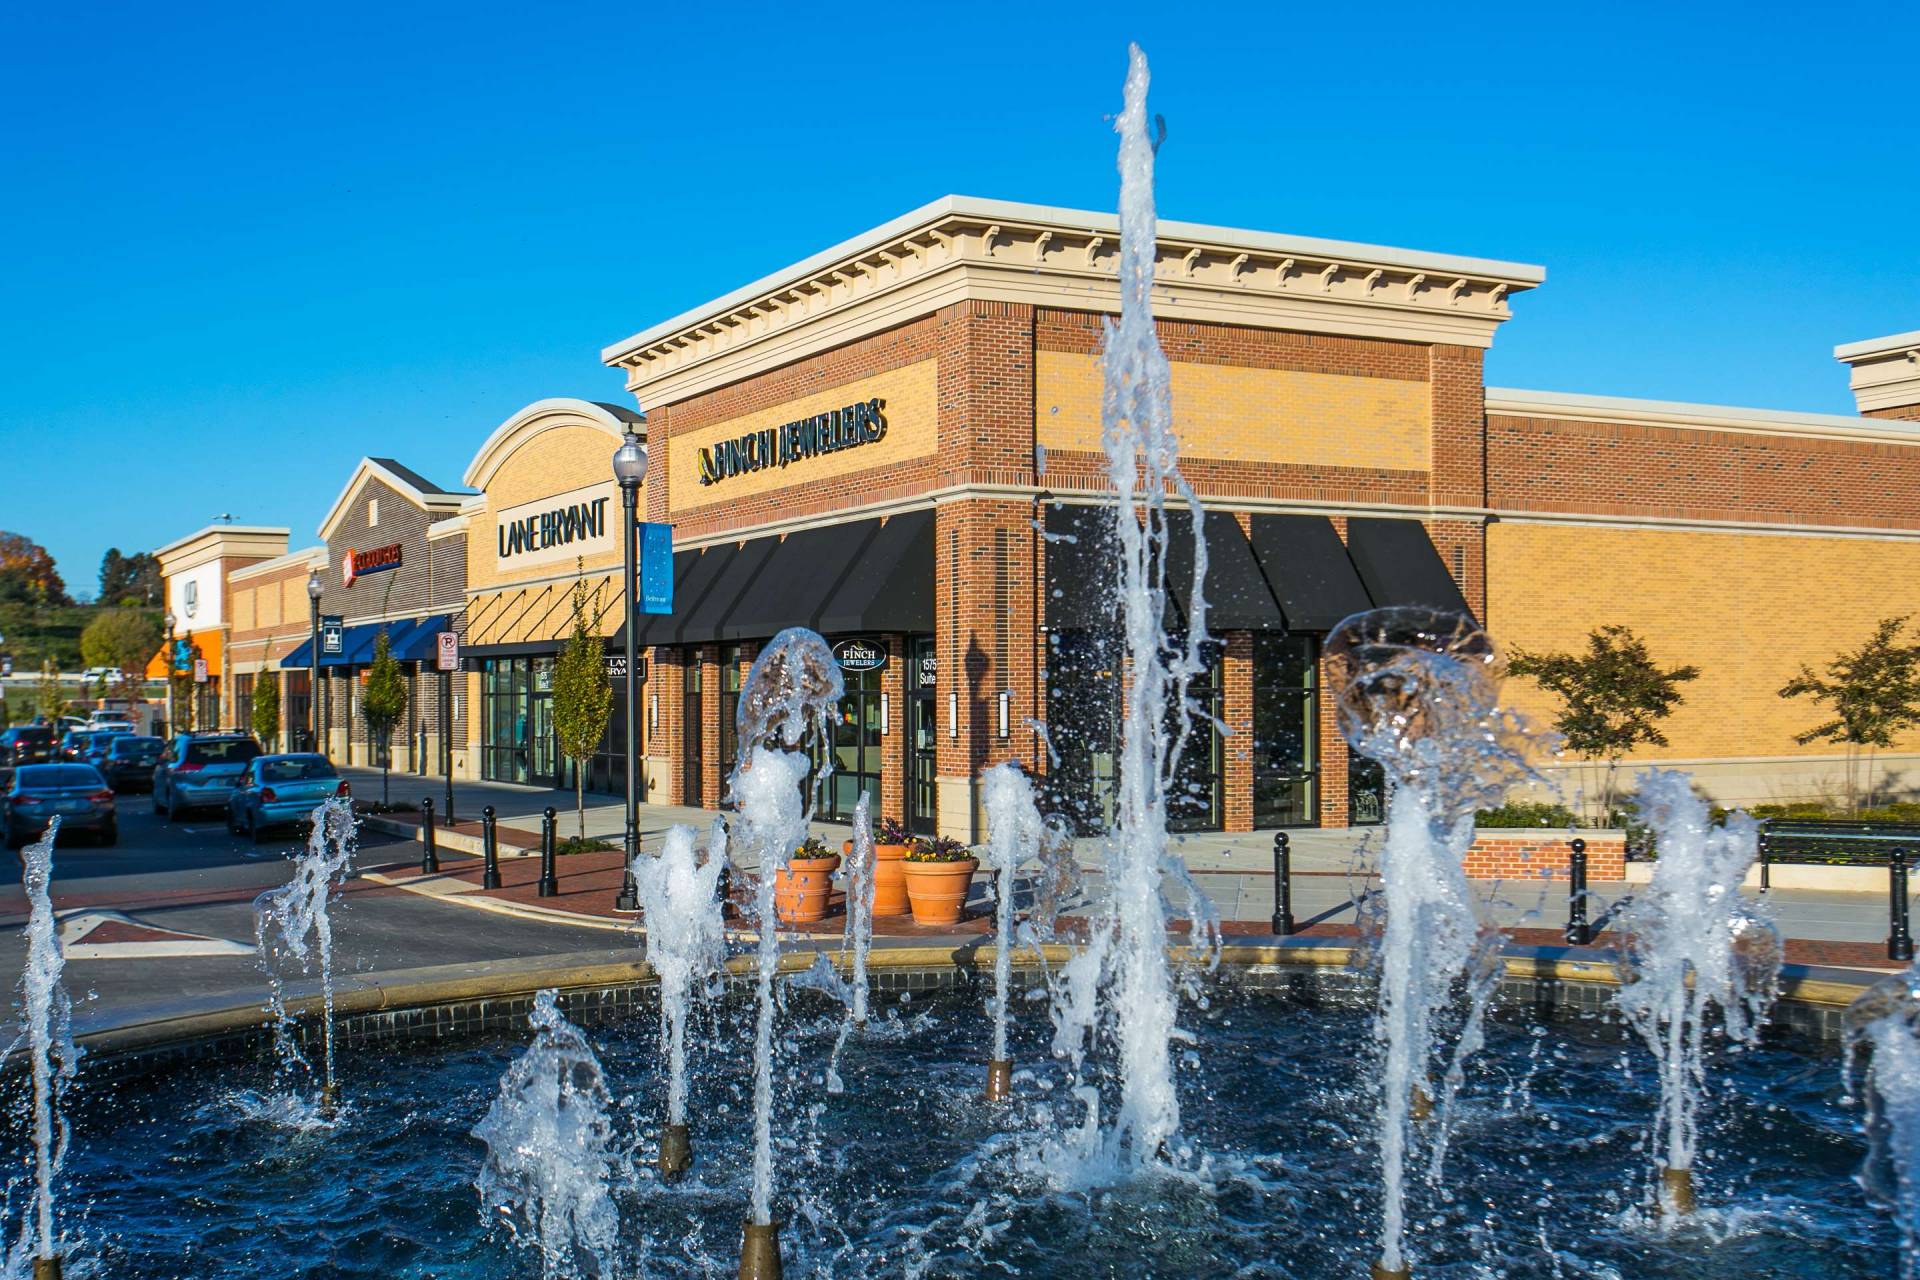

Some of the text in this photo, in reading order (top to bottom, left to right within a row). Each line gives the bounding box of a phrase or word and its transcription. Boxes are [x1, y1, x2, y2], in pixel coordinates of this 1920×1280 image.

[714, 398, 888, 480] FINCH JEWELERS
[499, 497, 609, 558] LANE BRYANT
[843, 648, 876, 659] FINCH
[923, 659, 937, 670] 1575
[920, 672, 936, 684] Suite
